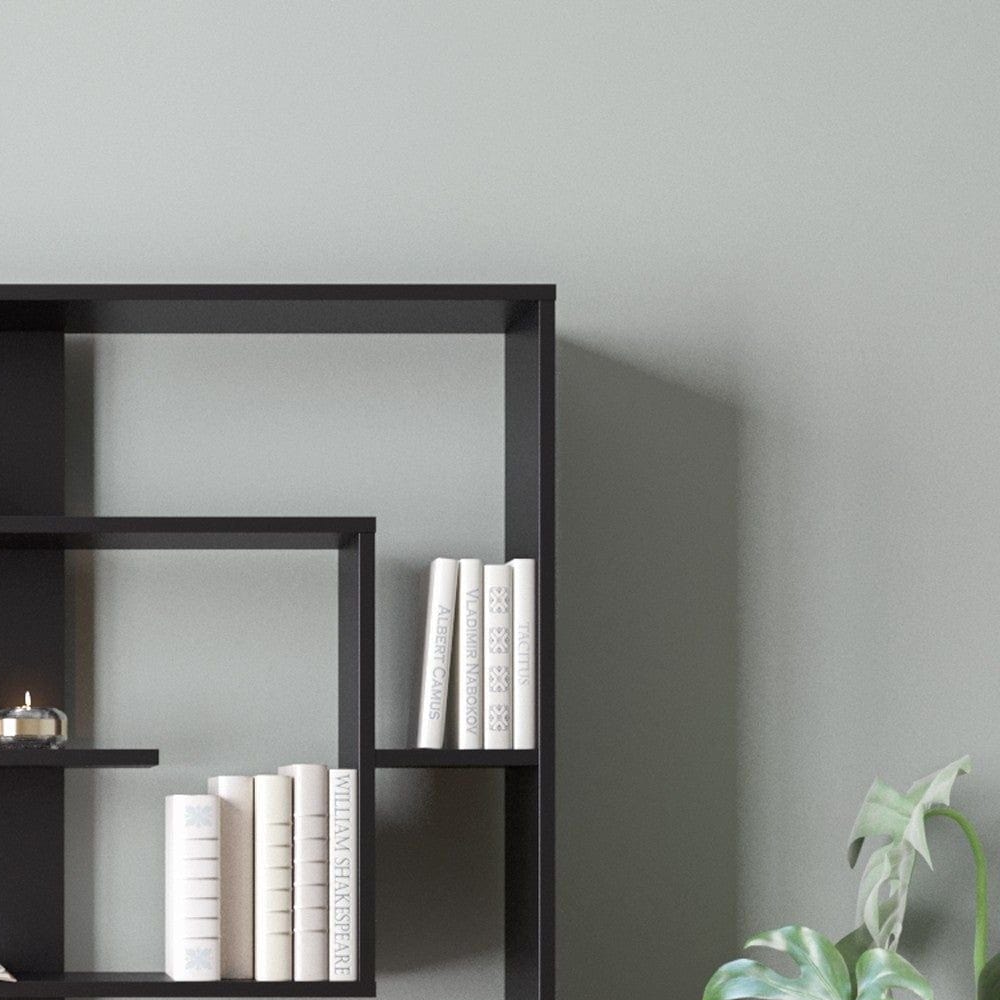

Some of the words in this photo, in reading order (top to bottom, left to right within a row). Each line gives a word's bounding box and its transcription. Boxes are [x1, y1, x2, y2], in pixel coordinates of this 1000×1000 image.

[433, 604, 451, 664] ALBERT
[465, 587, 480, 658] VLADIMIR
[518, 622, 530, 685] TACITUS
[429, 666, 446, 720] CAMUS
[465, 663, 480, 735] NABOKOV
[334, 773, 350, 852] WILLIAM
[334, 858, 350, 975] SHAKESPEARE
